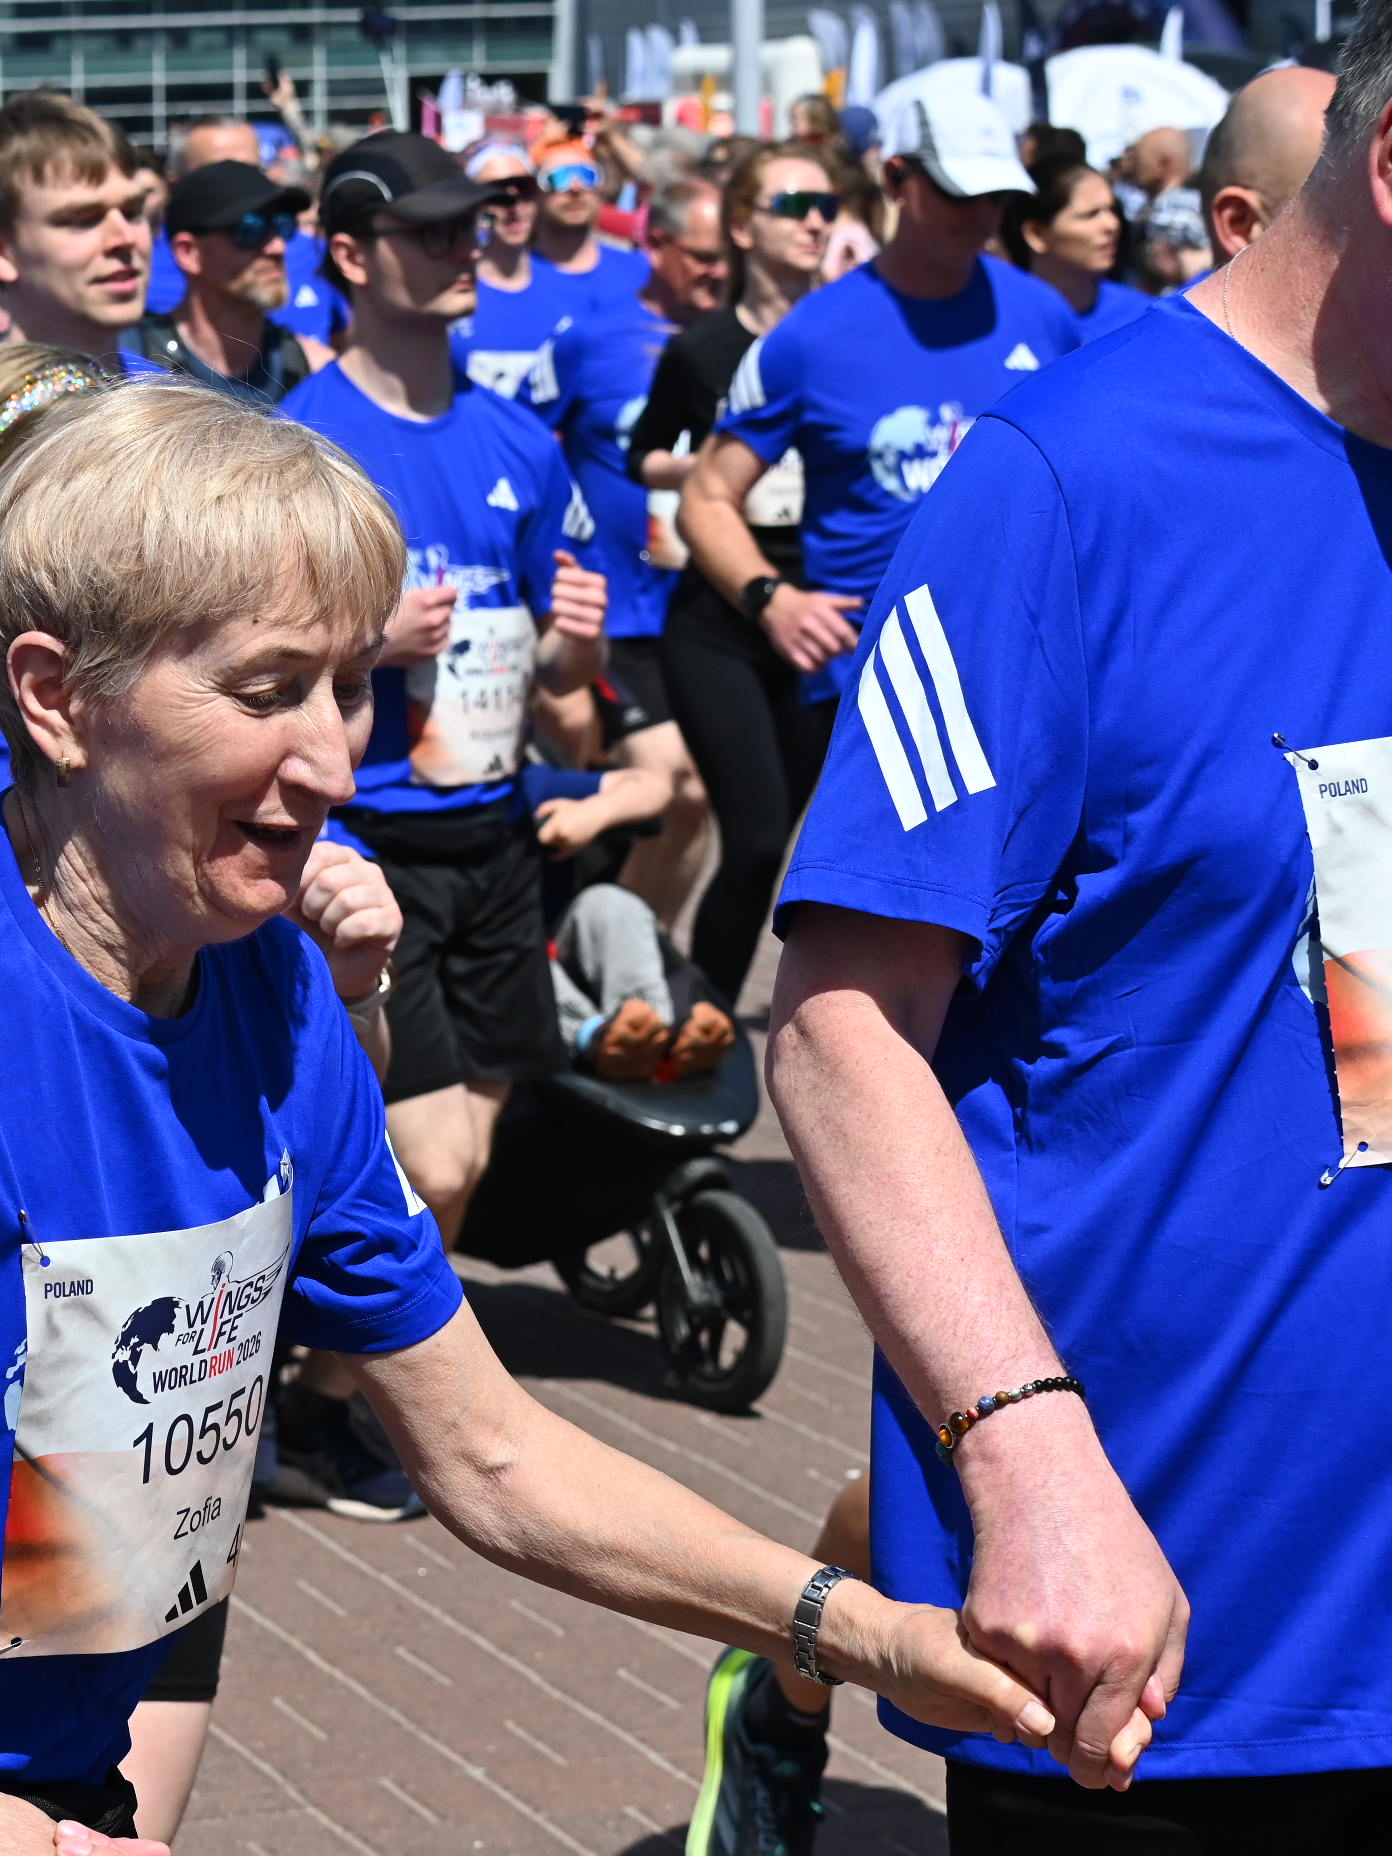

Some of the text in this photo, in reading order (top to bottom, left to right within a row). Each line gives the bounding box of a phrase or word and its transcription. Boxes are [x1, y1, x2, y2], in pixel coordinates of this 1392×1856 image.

[1319, 778, 1368, 799] POLAND
[44, 1278, 94, 1299] POLAND
[175, 1312, 243, 1356] FOR LIFE
[235, 1331, 262, 1366] 2026
[132, 1374, 263, 1484] 10550
[173, 1496, 222, 1541] Zofia
